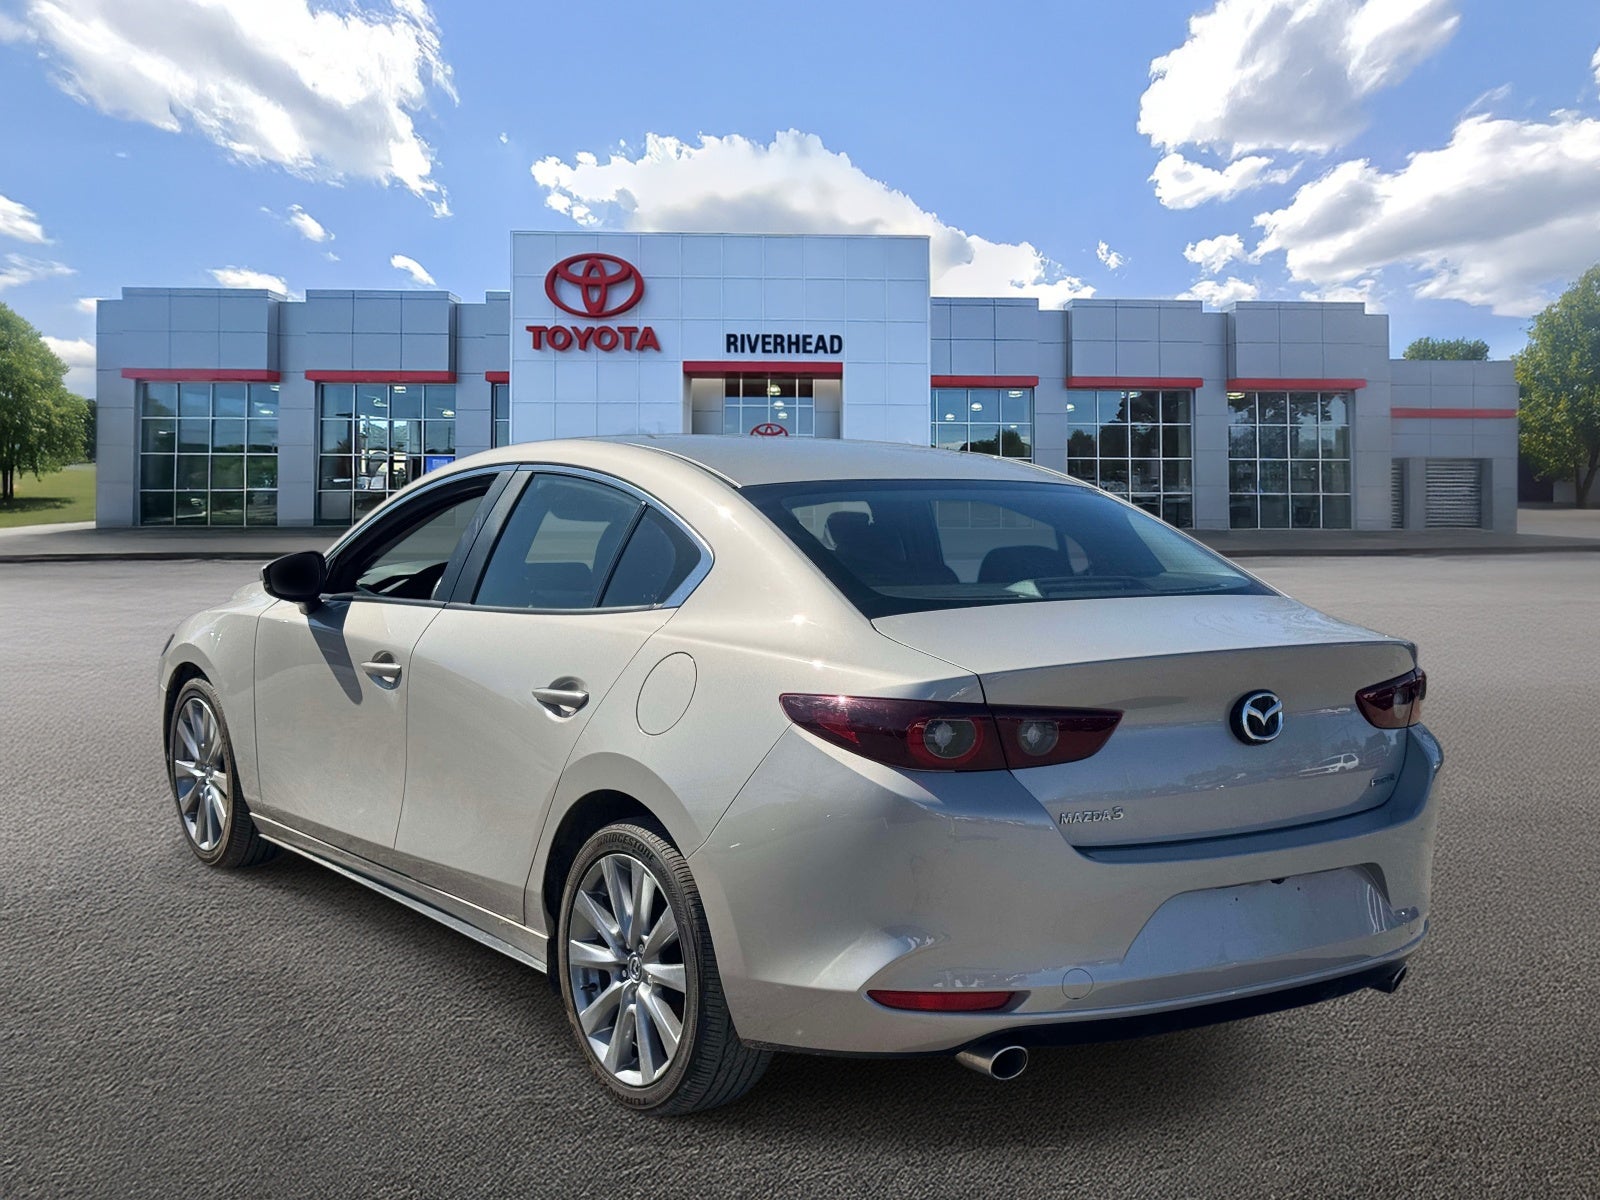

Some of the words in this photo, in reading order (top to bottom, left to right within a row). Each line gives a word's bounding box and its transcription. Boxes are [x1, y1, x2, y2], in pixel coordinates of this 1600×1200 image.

[525, 325, 662, 352] TOYOTA
[725, 333, 844, 354] RIVERHEAD
[1059, 805, 1125, 825] MAZDA3
